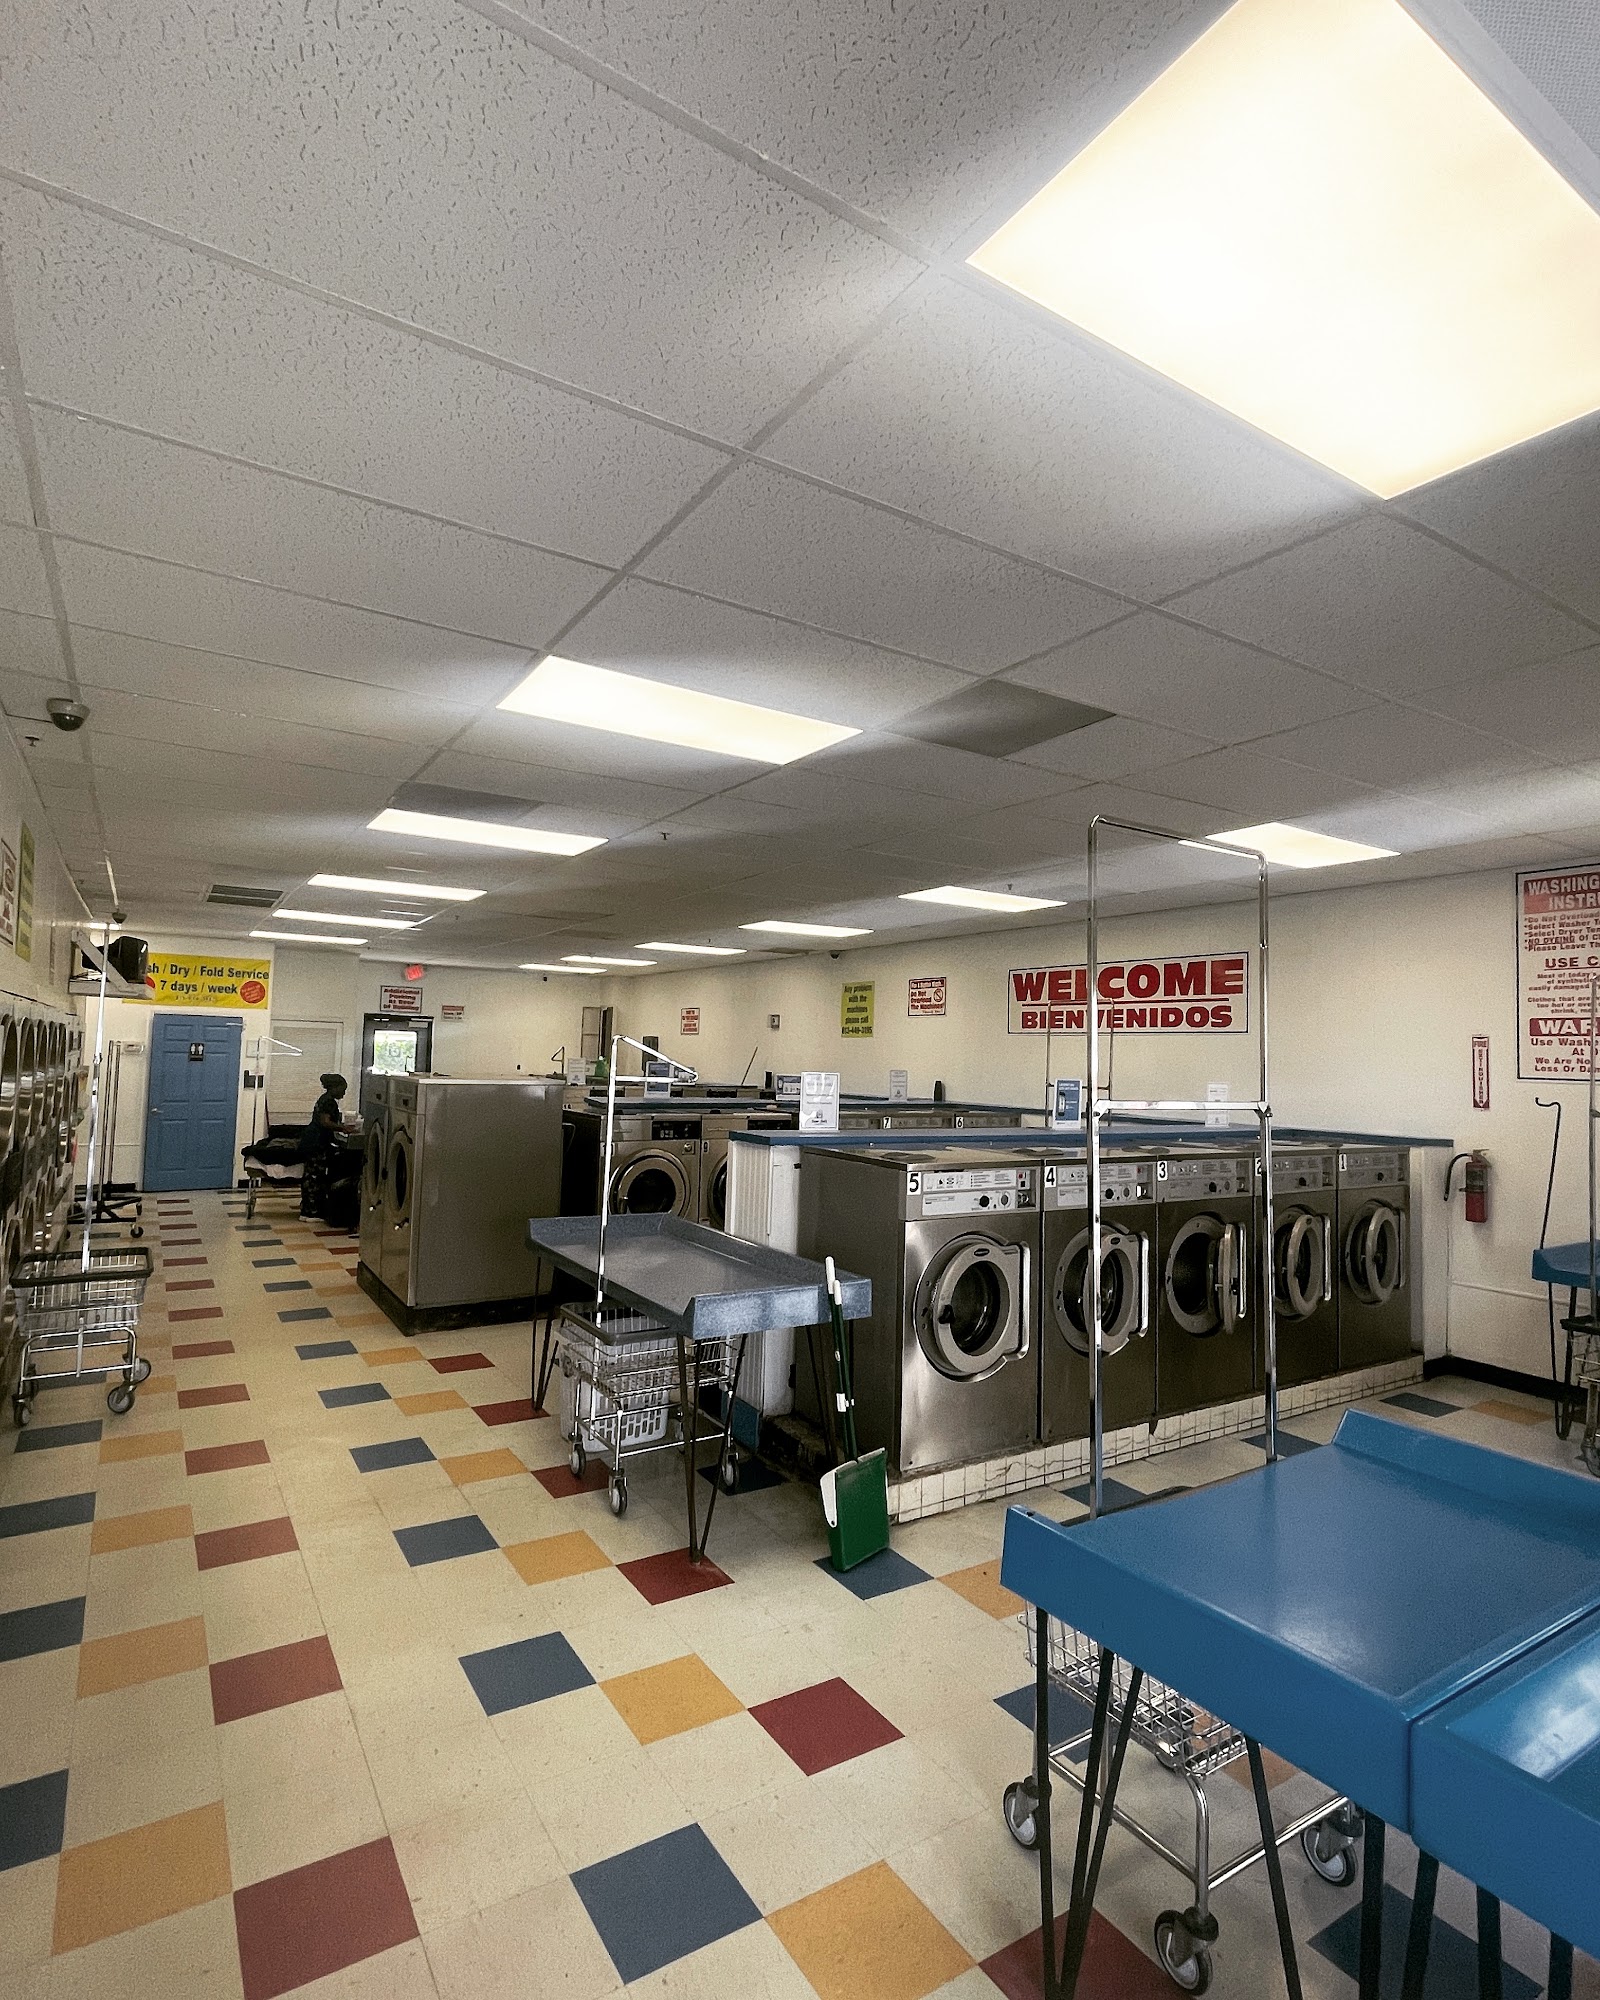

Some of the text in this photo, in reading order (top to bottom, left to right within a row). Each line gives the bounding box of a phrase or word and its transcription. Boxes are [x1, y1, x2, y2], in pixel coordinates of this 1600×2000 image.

[1528, 874, 1600, 896] WASHING
[1558, 920, 1590, 928] Washer
[1528, 930, 1554, 938] Select
[1558, 928, 1582, 936] Dryer
[1528, 944, 1556, 952] Please
[1560, 942, 1586, 950] Leave
[1545, 956, 1600, 968] USE C
[147, 963, 159, 974] sh
[170, 964, 190, 978] Dry
[200, 966, 224, 977] Fold
[227, 968, 270, 980] Service
[160, 980, 167, 990] 7
[170, 980, 198, 994] days
[208, 984, 238, 994] week
[1012, 958, 1244, 1002] WELCOME
[1022, 1006, 1232, 1029] BIENVENIDOS
[1474, 1040, 1487, 1048] FIRE
[1531, 1038, 1553, 1046] Use
[1572, 1047, 1584, 1056] At
[884, 1118, 890, 1128] 7
[957, 1118, 962, 1128] 6
[1256, 1160, 1262, 1174] 2
[1341, 1156, 1346, 1170] 1
[1046, 1168, 1054, 1185] 4
[1159, 1162, 1166, 1179] 3
[909, 1173, 920, 1192] 5
